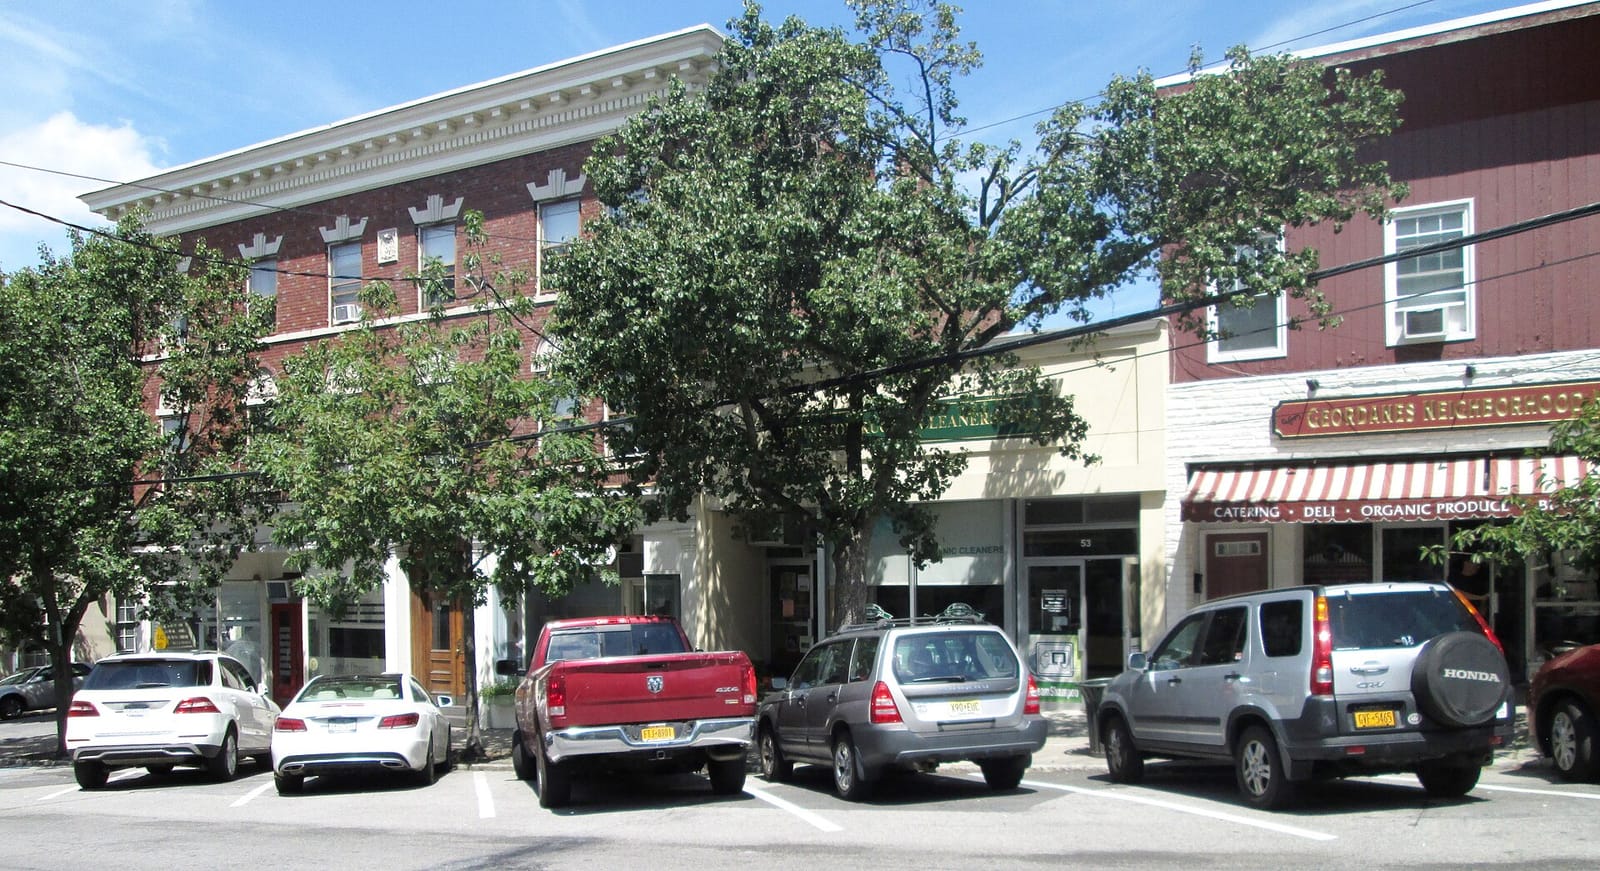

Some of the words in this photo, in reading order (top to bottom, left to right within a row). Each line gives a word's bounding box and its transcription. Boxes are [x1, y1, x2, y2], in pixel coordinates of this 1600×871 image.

[1307, 402, 1416, 429] GEORDANES
[1423, 392, 1584, 421] NEIGHBORHOOD
[919, 411, 993, 430] LEANER
[1213, 506, 1280, 518] CATERING
[1304, 506, 1335, 517] DELI
[1360, 503, 1431, 517] ORGANIC
[1080, 539, 1092, 548] 53
[1444, 668, 1500, 683] HONDA
